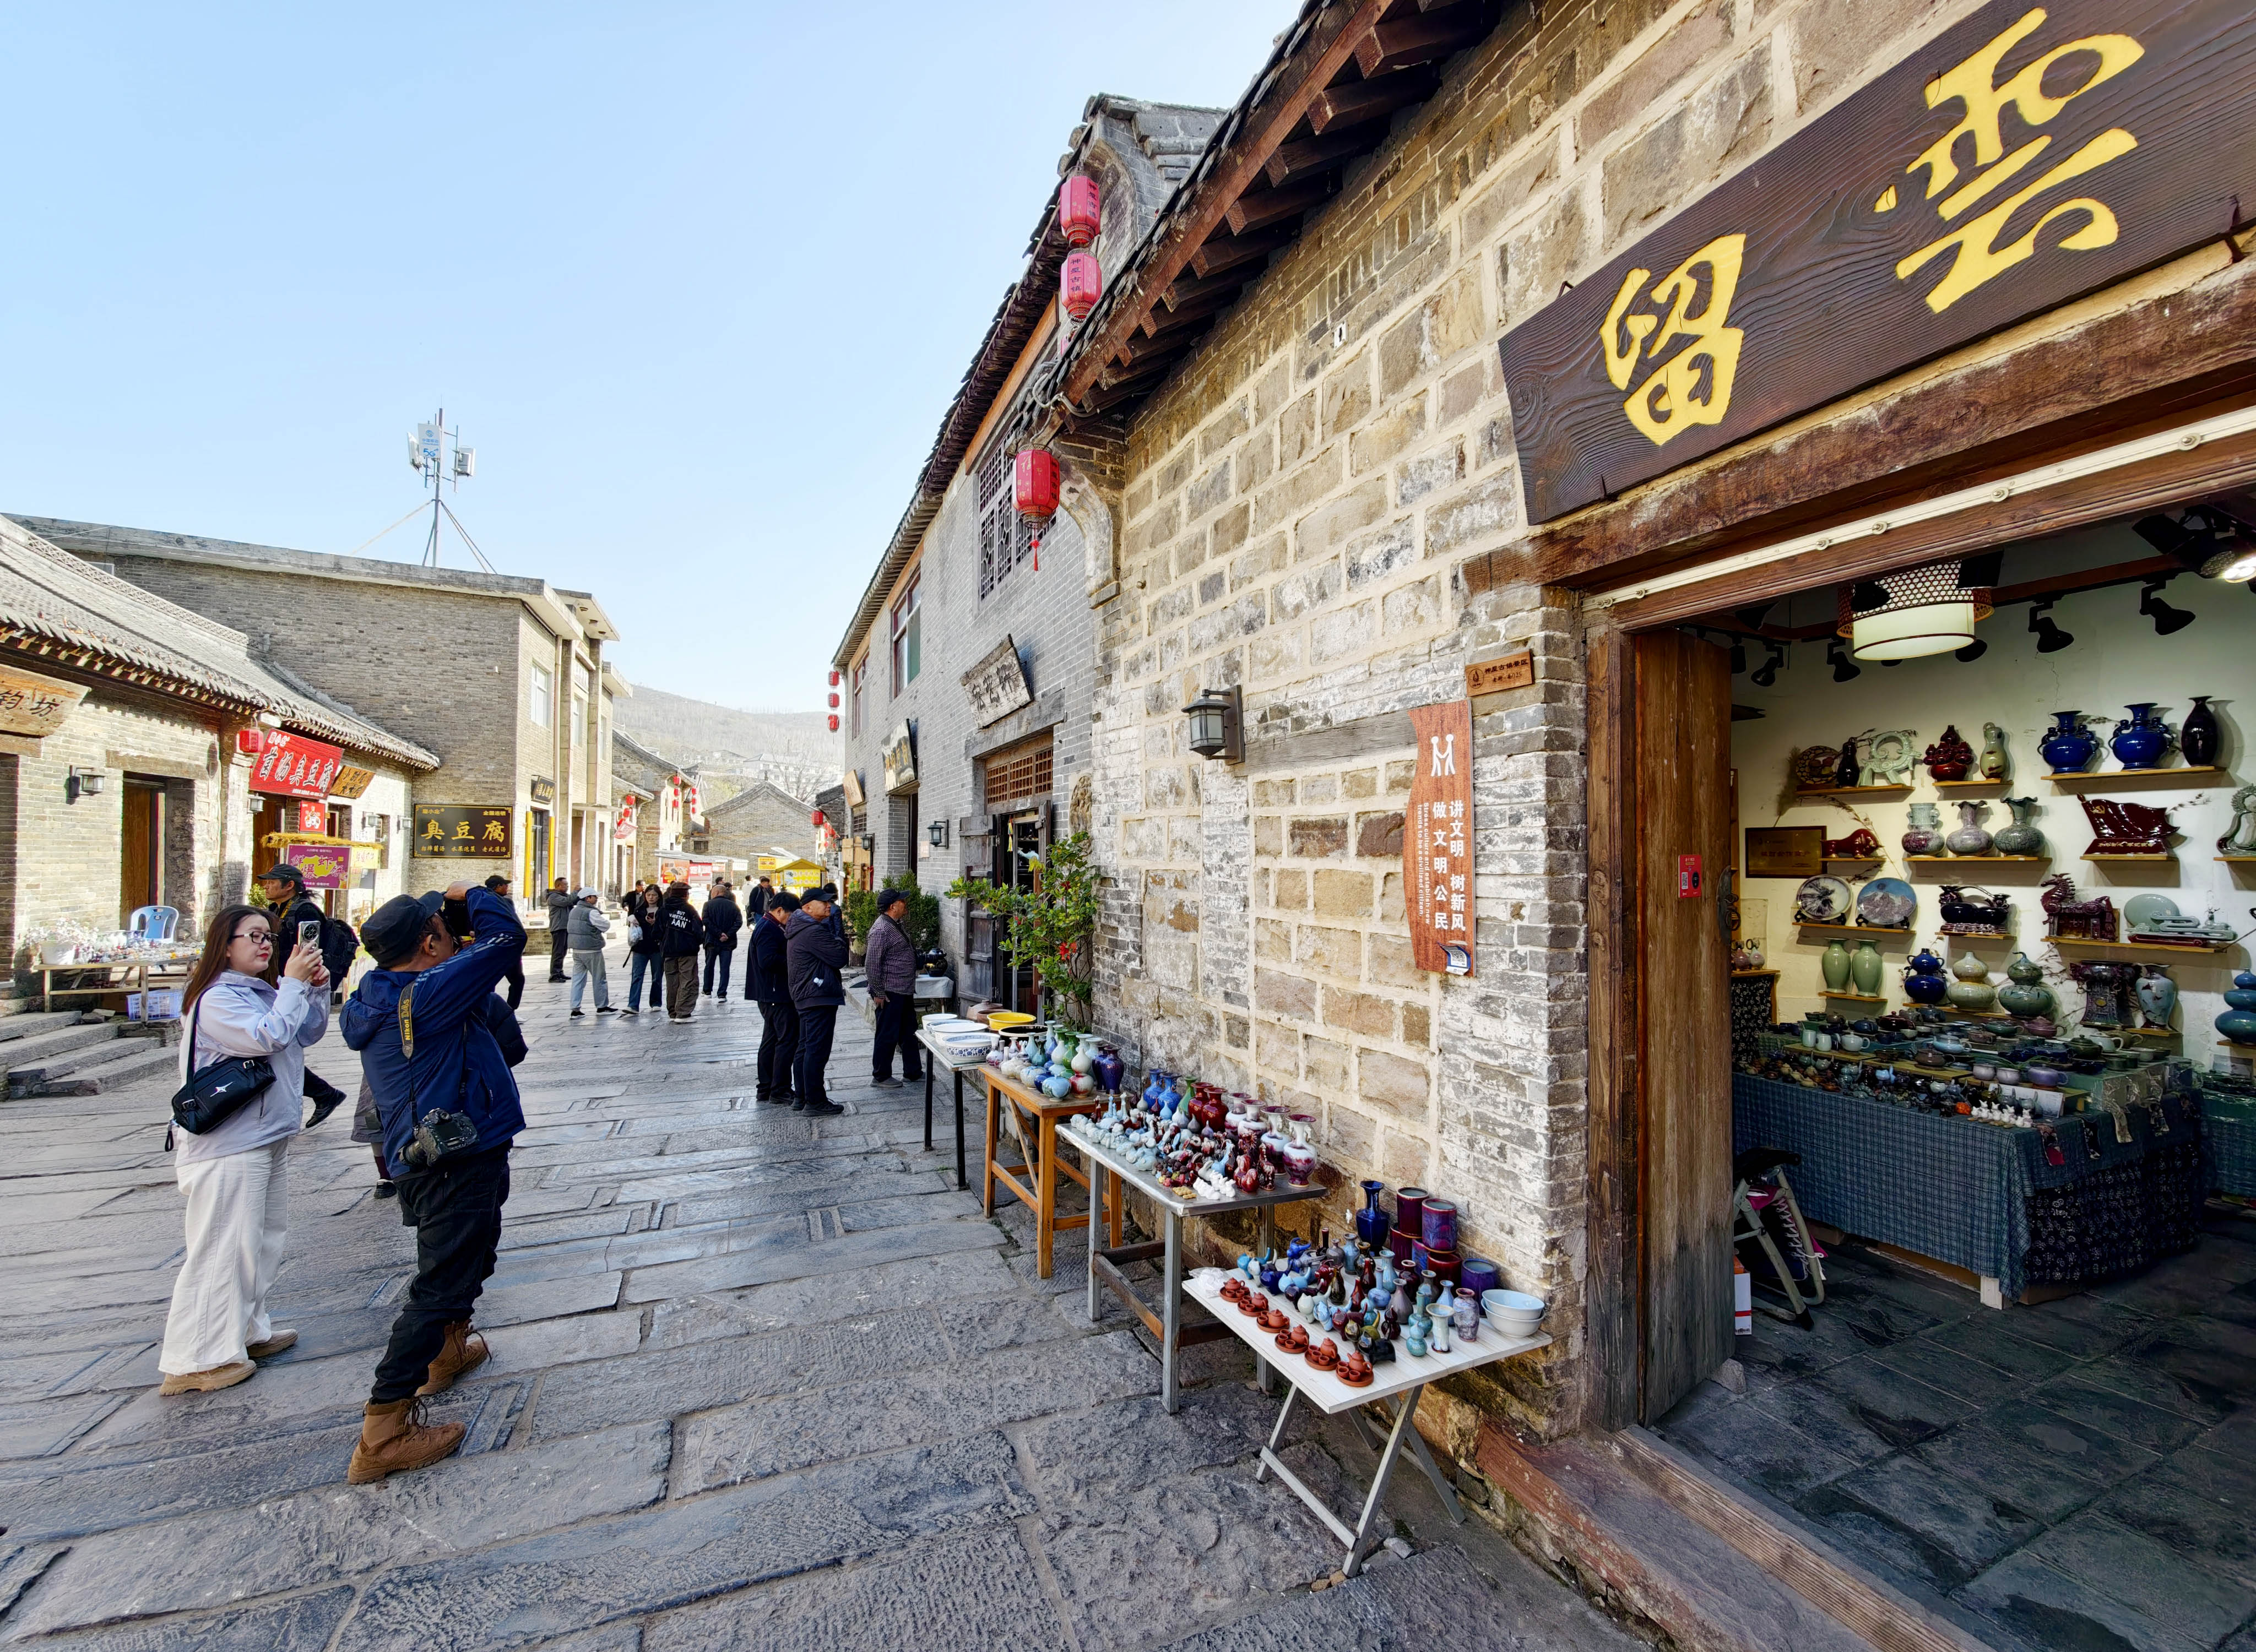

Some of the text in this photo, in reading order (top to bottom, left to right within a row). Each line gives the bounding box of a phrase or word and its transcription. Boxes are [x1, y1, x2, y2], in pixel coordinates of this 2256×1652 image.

[421, 819, 505, 843] 臭豆腐
[1418, 840, 1423, 849] be
[1433, 802, 1448, 930] 做文明公民
[1449, 800, 1466, 931] 讲文明 树新风
